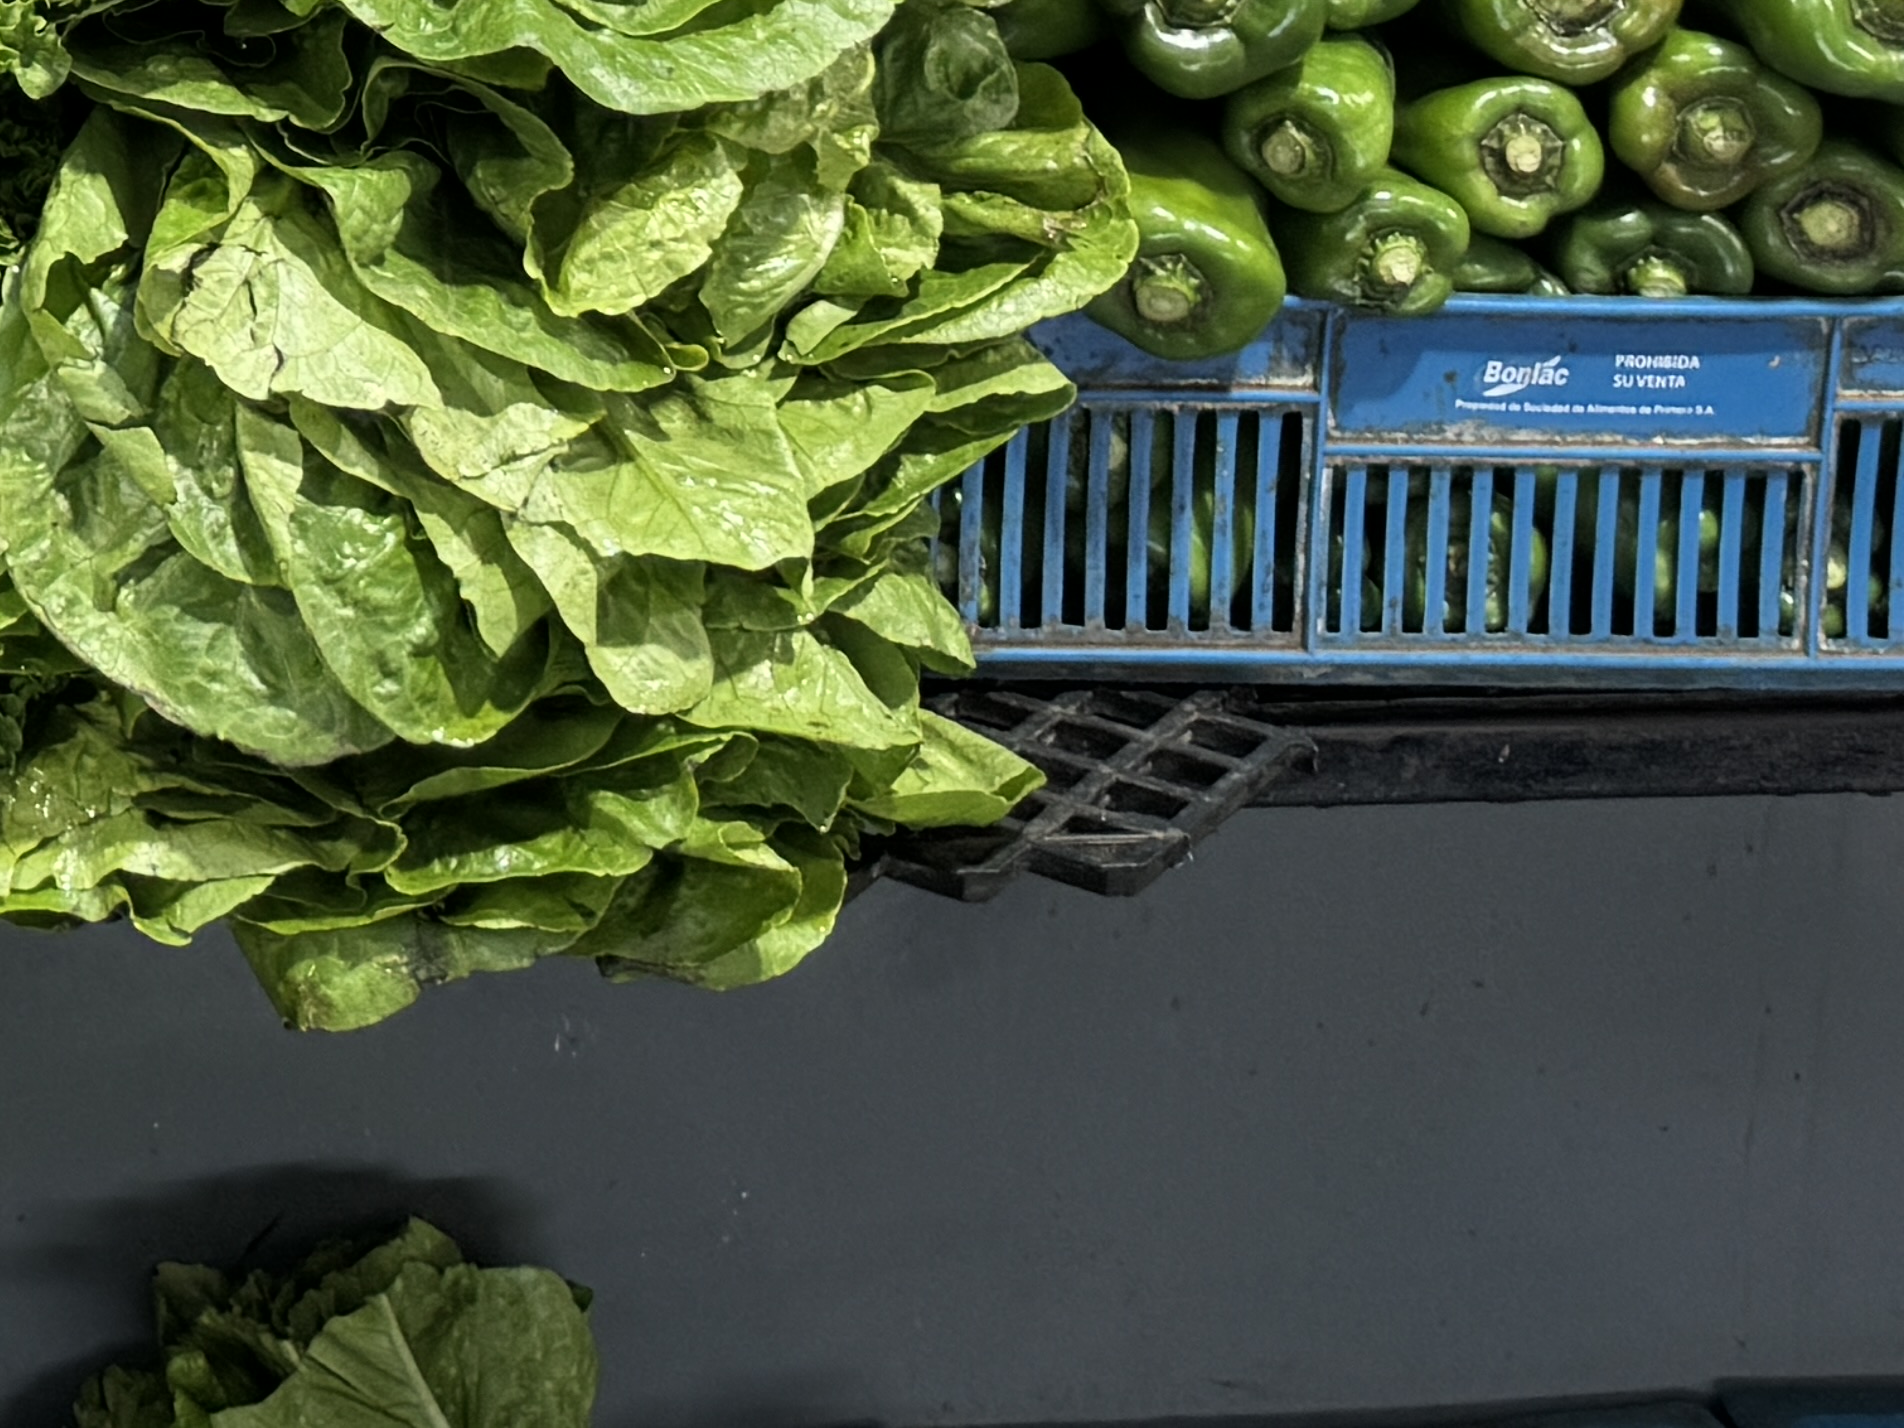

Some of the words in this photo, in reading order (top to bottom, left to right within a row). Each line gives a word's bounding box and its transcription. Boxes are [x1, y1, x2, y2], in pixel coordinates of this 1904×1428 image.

[1614, 354, 1701, 370] PROHIBIDA
[1483, 357, 1570, 387] Bonlac
[1612, 374, 1634, 389] SU
[1635, 375, 1687, 389] VENTA
